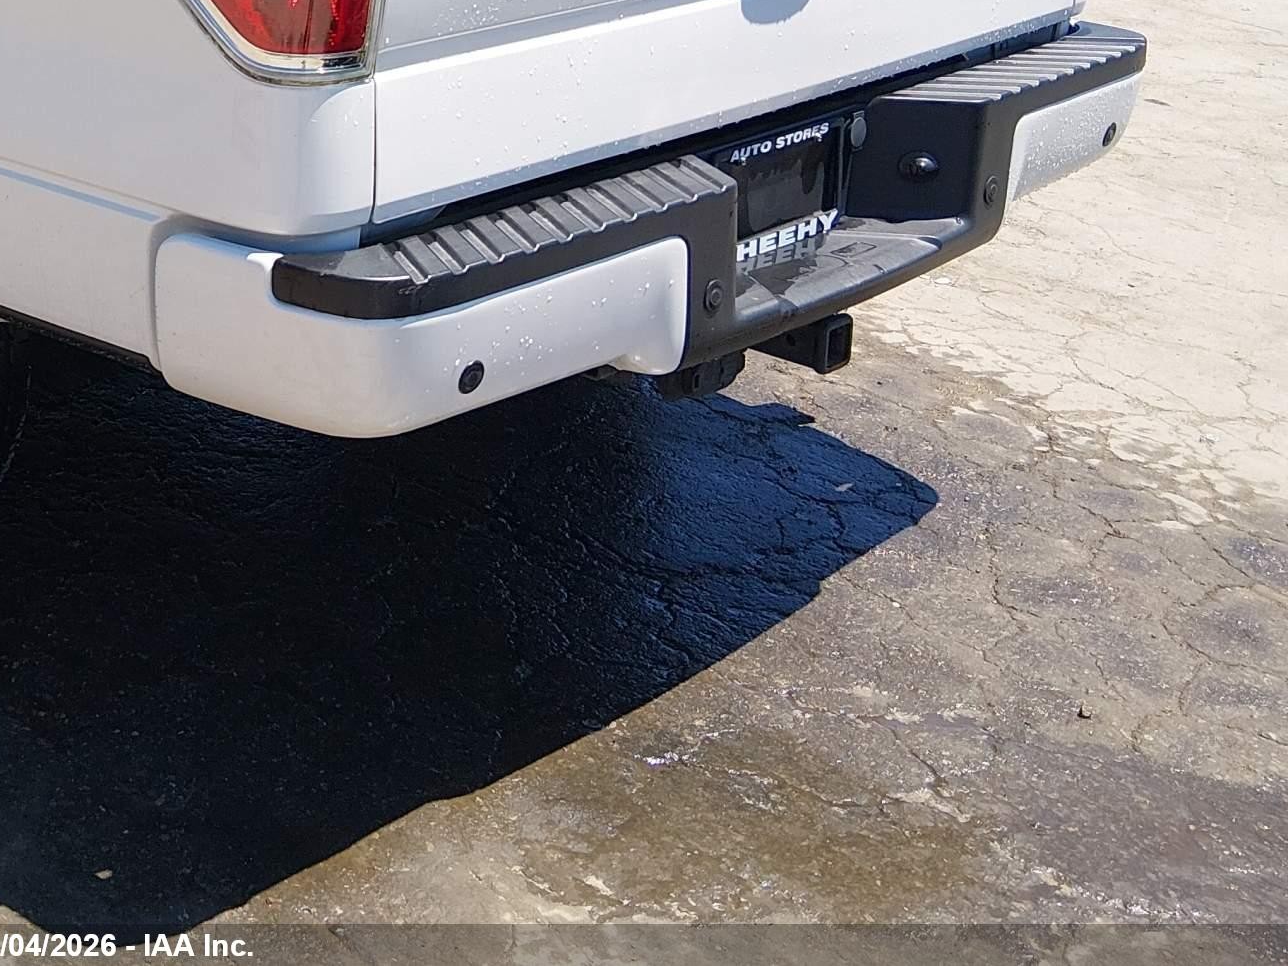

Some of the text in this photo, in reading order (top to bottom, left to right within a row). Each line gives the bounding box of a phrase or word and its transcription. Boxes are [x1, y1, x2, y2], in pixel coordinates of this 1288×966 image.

[730, 122, 829, 163] AUTO STORES
[736, 208, 838, 262] HEEHY
